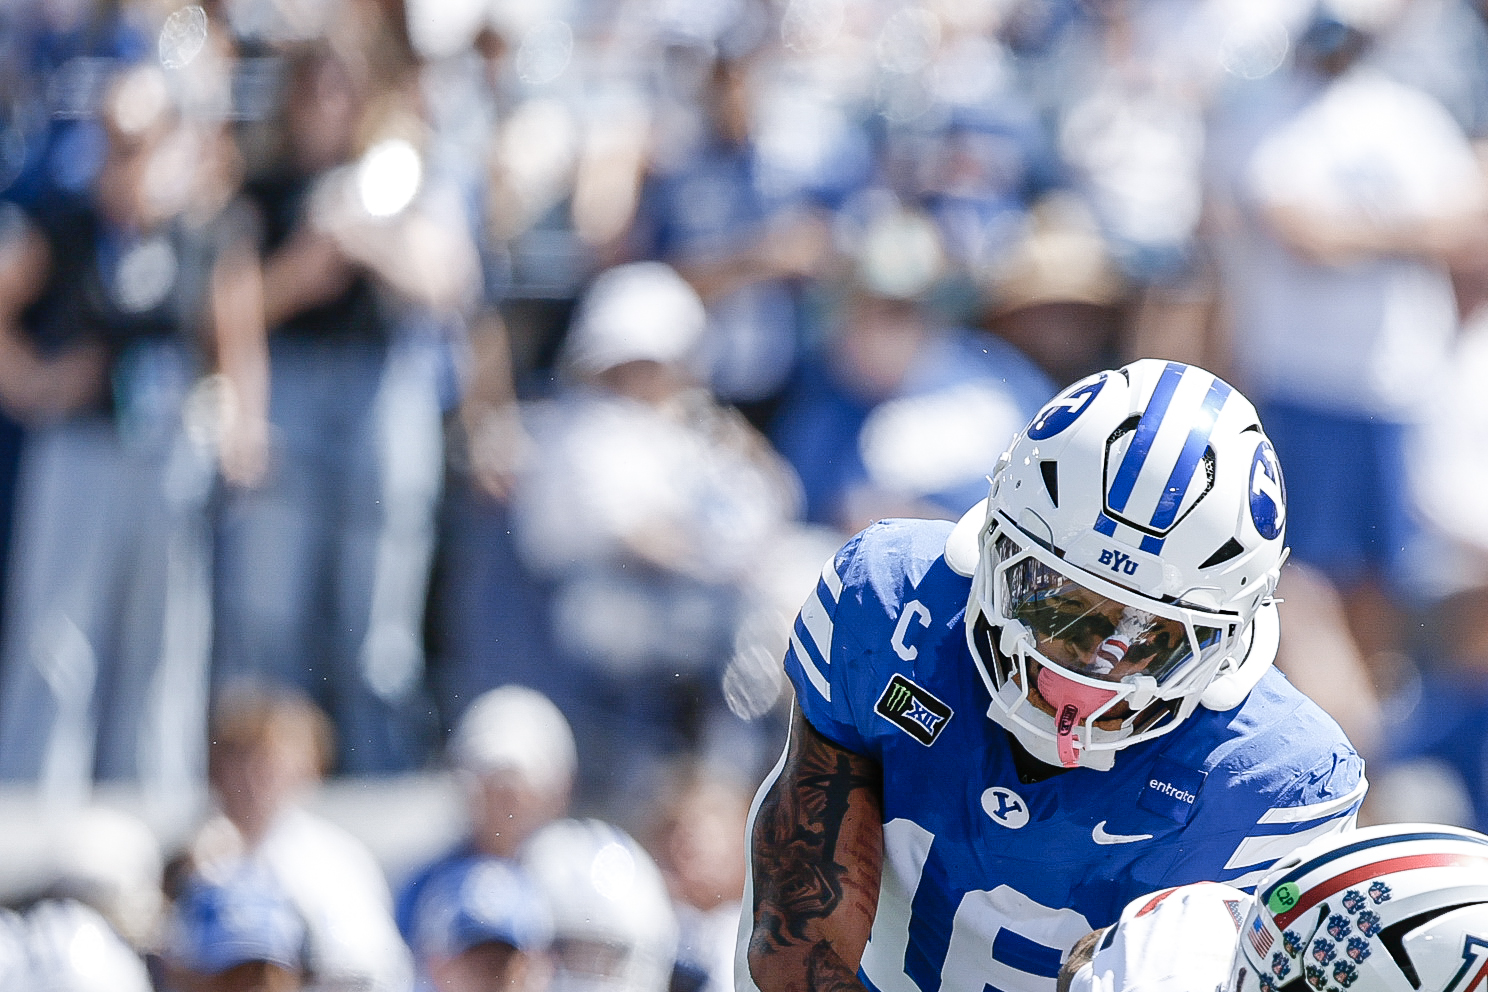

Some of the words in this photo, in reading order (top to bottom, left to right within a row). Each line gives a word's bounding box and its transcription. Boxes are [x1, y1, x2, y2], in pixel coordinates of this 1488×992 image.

[1098, 549, 1139, 575] BYU
[891, 599, 932, 661] C
[1149, 779, 1196, 804] entrata
[993, 791, 1022, 820] Y
[1276, 886, 1294, 906] C2P
